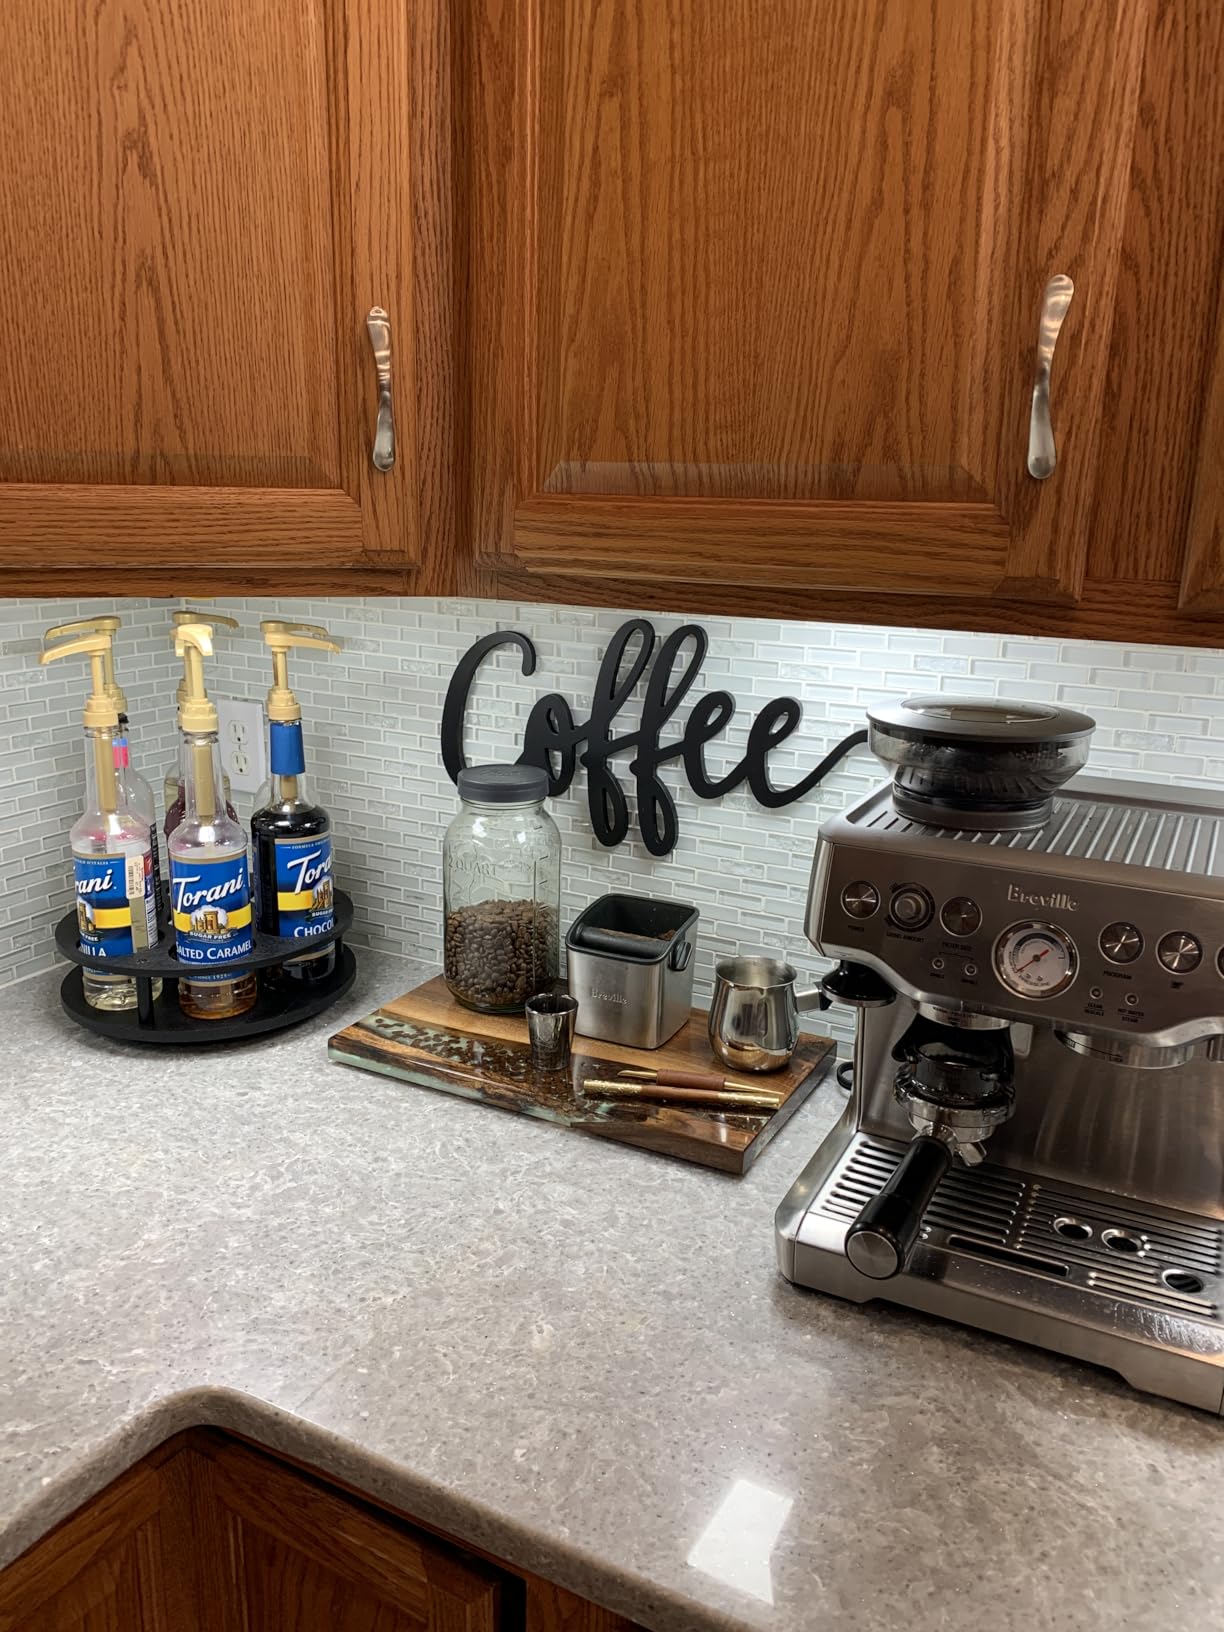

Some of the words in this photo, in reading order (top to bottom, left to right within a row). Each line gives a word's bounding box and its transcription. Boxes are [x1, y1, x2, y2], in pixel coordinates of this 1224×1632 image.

[441, 618, 868, 857] Coffee
[287, 849, 333, 895] Tora
[172, 867, 244, 914] Torani
[1007, 883, 1080, 912] Breville
[189, 931, 212, 940] SUGAR
[213, 932, 231, 940] FREE
[293, 918, 334, 938] CHOCOL
[206, 939, 252, 960] CARAMEL
